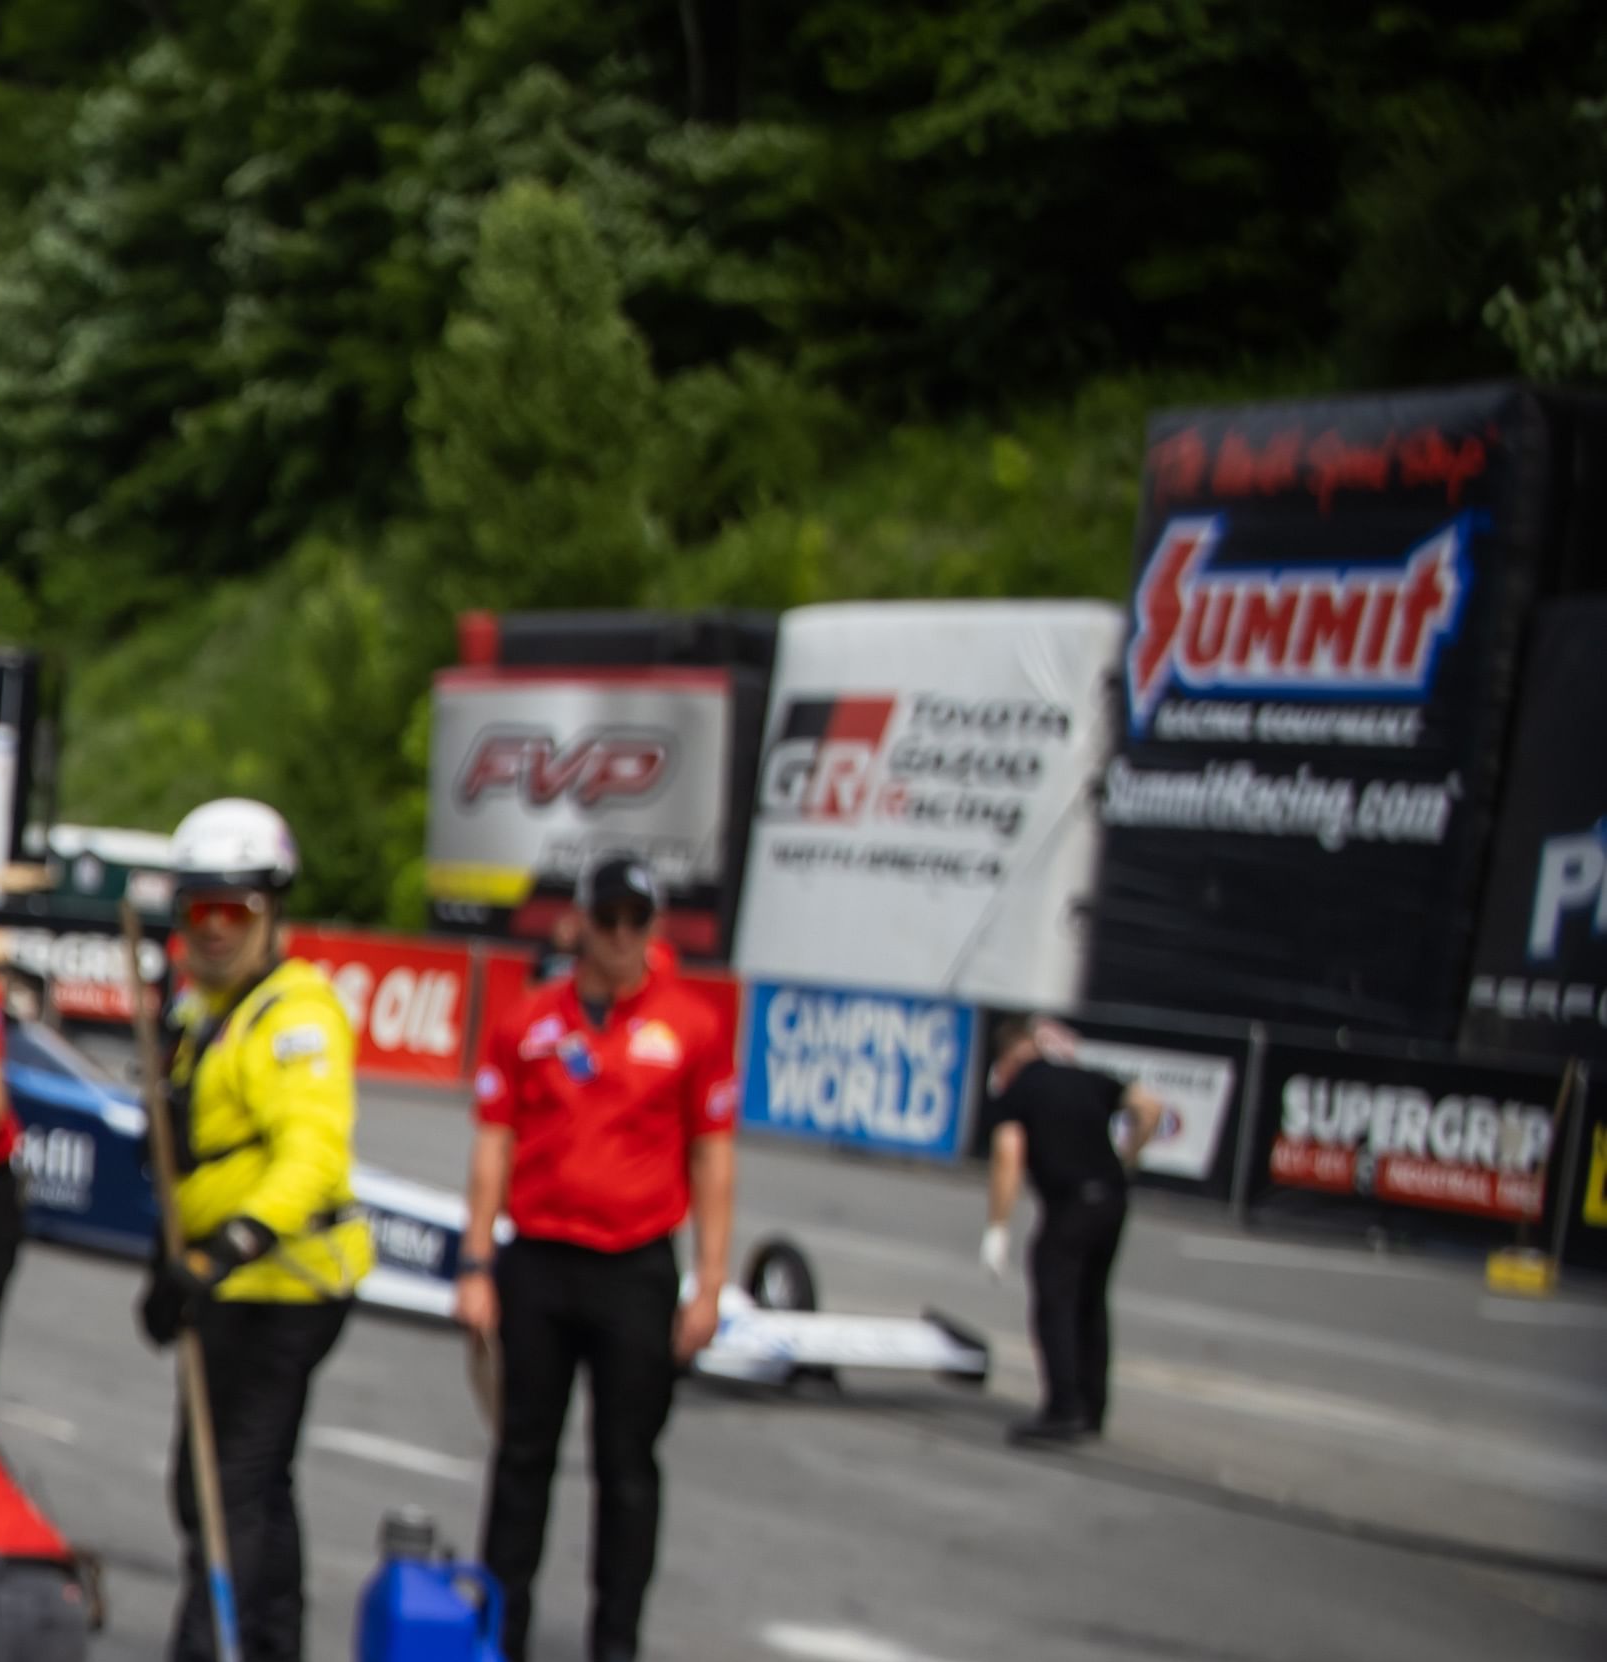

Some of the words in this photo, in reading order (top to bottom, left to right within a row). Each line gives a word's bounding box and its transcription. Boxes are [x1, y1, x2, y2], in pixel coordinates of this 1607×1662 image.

[458, 732, 672, 812] FVP
[371, 964, 461, 1058] OIL
[765, 988, 960, 1070] CAMPING
[765, 1054, 958, 1146] WORLD
